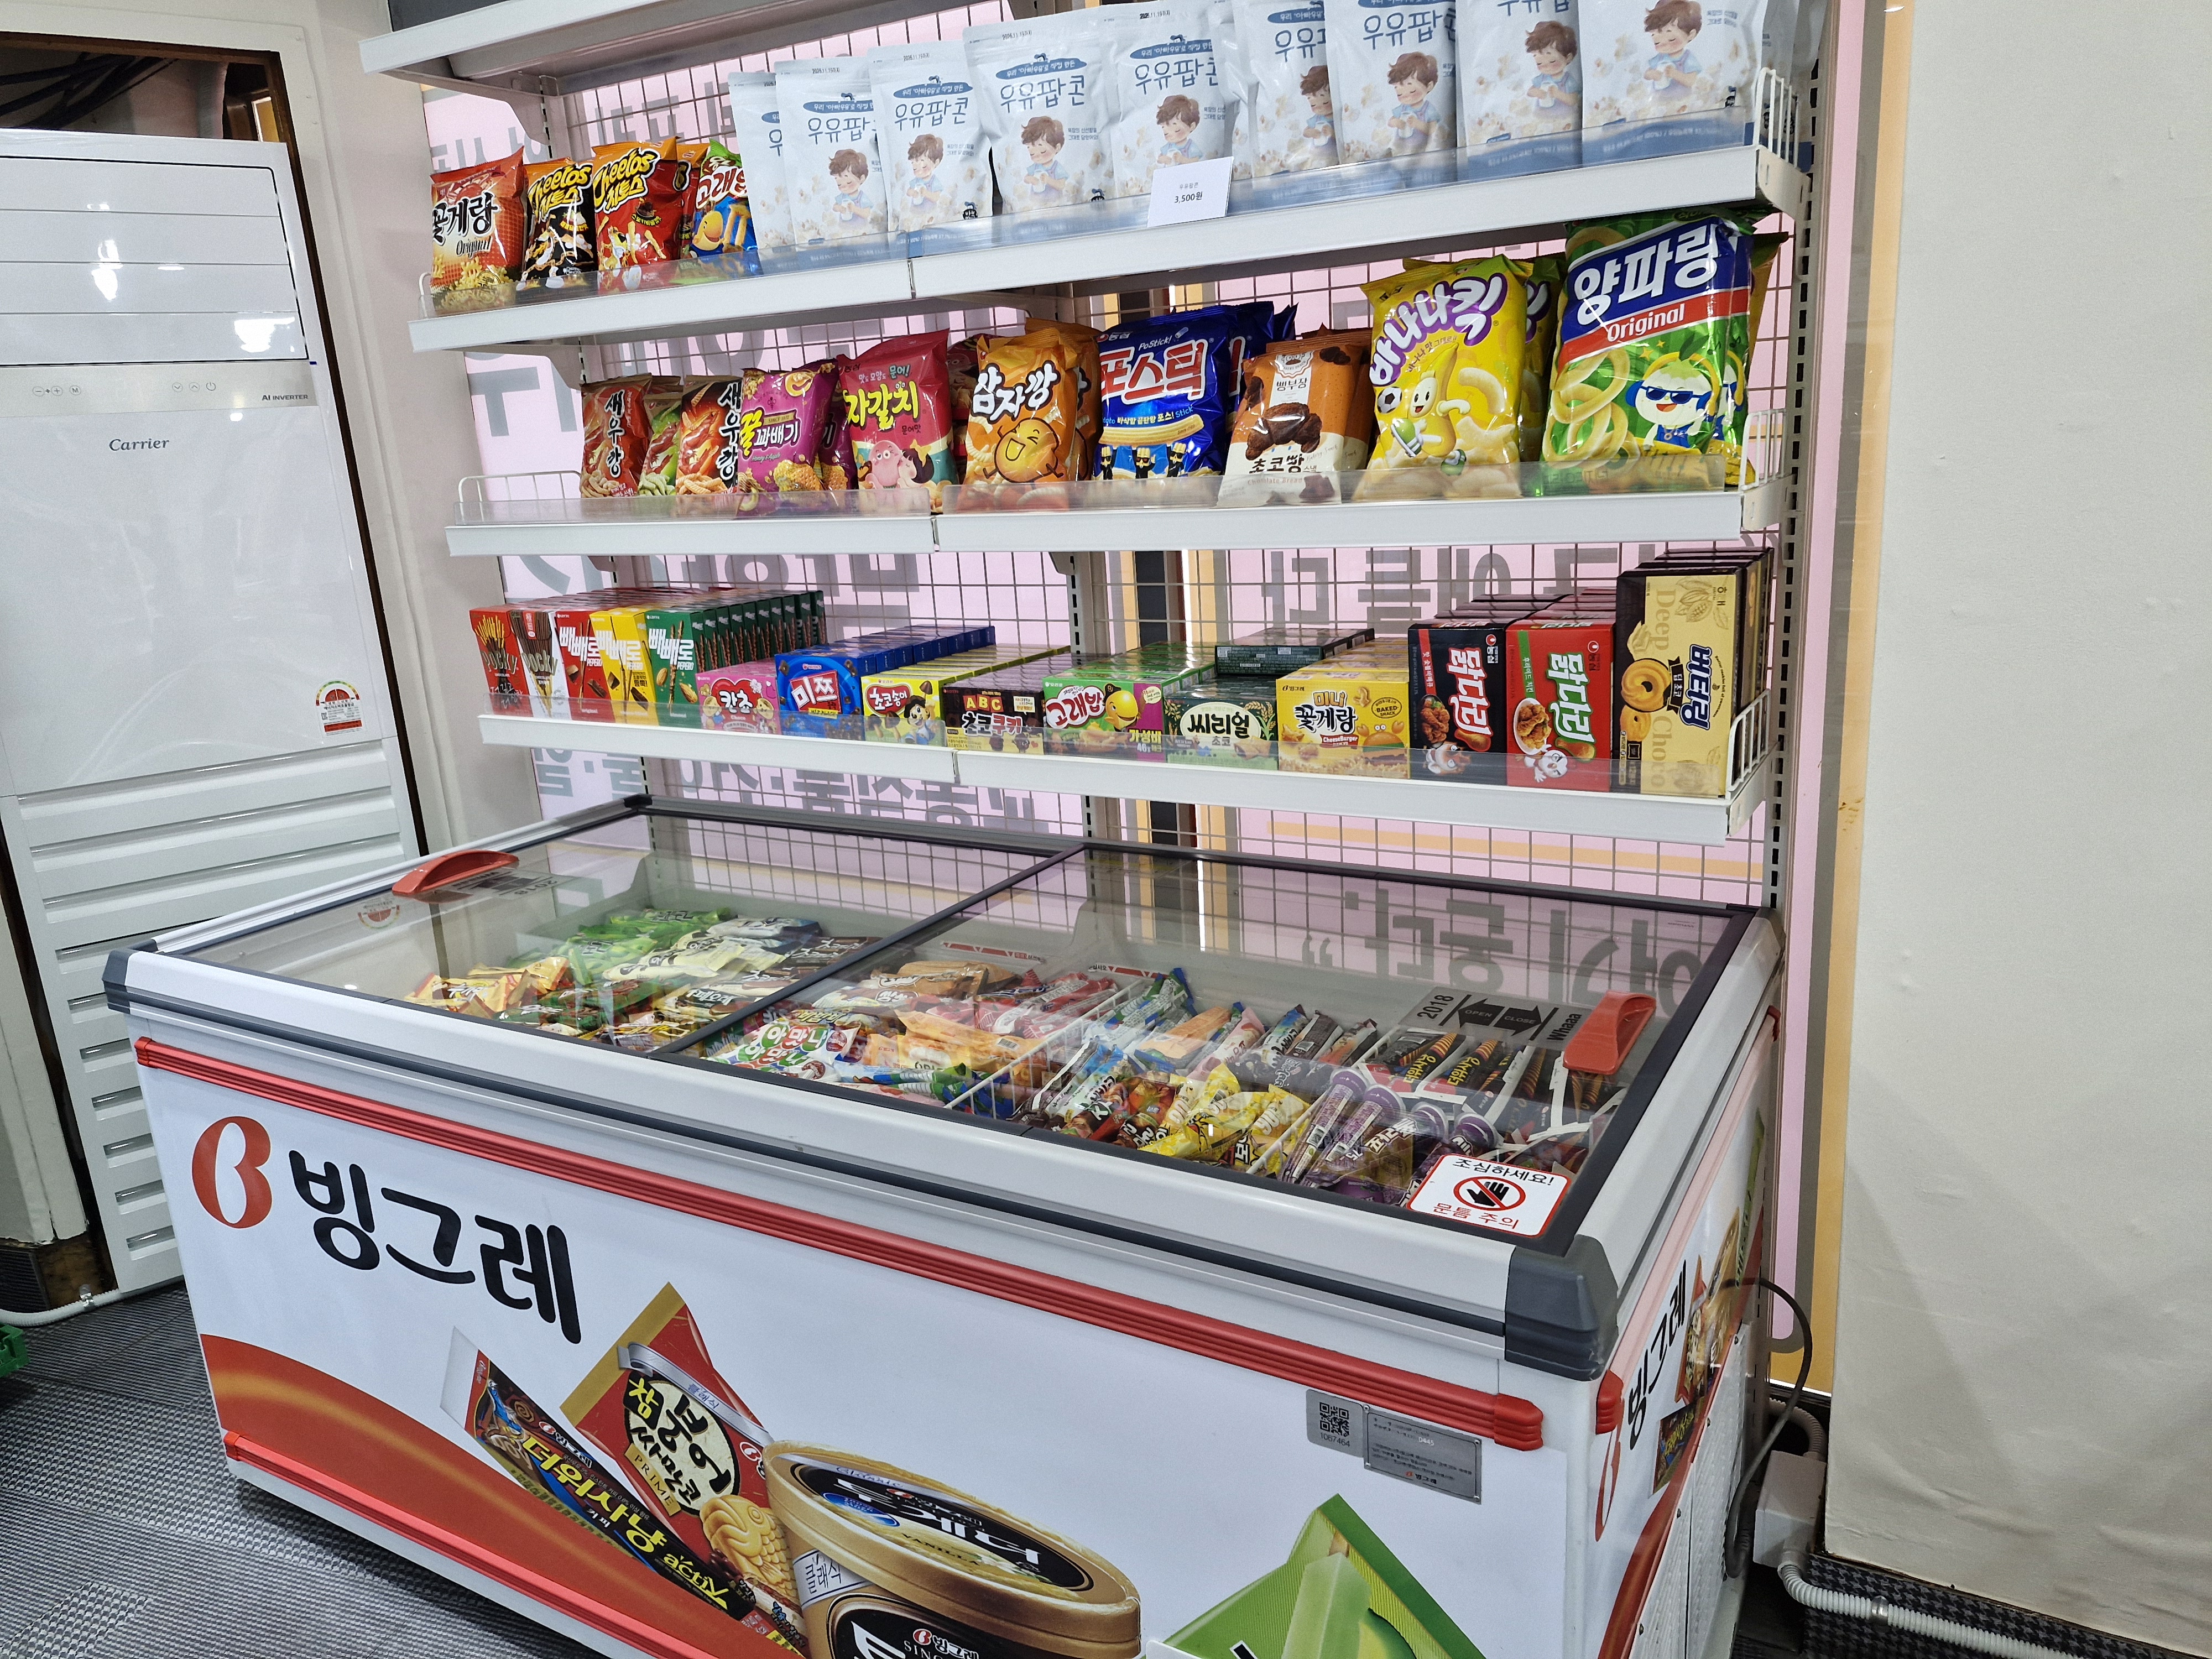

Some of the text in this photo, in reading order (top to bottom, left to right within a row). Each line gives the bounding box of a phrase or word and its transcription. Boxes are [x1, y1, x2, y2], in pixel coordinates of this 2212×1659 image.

[999, 75, 1086, 114] 우유팝콘
[894, 97, 969, 131] 우유팝콘
[807, 118, 877, 145] 우유팝
[606, 178, 645, 212] 치토스
[1173, 191, 1203, 204] 3,500원
[1180, 181, 1199, 191] 우유팝콘
[540, 187, 582, 216] 치토스
[456, 238, 492, 258] Original
[1574, 223, 1719, 326] 양파링
[1369, 275, 1505, 387] 바나나킥
[1607, 303, 1685, 342] Original
[1138, 336, 1172, 352] PoStick!
[1425, 341, 1434, 351] 맛
[858, 365, 911, 383] 맛도 모양도 문어!
[1099, 341, 1206, 403] 포스틱
[1276, 377, 1308, 392] 빵부장
[843, 381, 920, 431] 자갈치
[1157, 412, 1174, 422] 포스!
[1175, 406, 1193, 419] Stick
[605, 389, 625, 479] 새우깡
[718, 382, 743, 481] 새우깡
[740, 409, 799, 458] 꿀꽈배기
[901, 424, 922, 435] 문어맛
[108, 437, 170, 452] Carrier
[1249, 453, 1305, 474] 초코빵
[1304, 464, 1317, 473] 스낵
[1649, 588, 1677, 651] Deep
[559, 627, 599, 662] 빼빼로
[596, 630, 641, 666] 빼빼로
[649, 628, 694, 665] 빼빼로
[627, 661, 643, 670] PEPERO
[677, 661, 694, 670] PEPERO
[791, 676, 838, 707] 미쯔
[869, 687, 908, 710] 초코송이
[1313, 691, 1347, 708] 미니
[1448, 648, 1492, 736] 닭다리
[1548, 653, 1596, 743] 닭다리
[1673, 674, 1683, 698] 딥 초코
[1679, 645, 1712, 730] 버터링
[719, 691, 754, 712] 칸쵸
[966, 696, 1002, 712] ABC
[1045, 692, 1101, 726] 고래밥
[963, 713, 1022, 736] 초코쿠키
[1187, 711, 1250, 739] 씨리얼
[1295, 705, 1357, 733] 꽃게랑
[1129, 729, 1162, 744] 가성비
[1651, 716, 1673, 787] Choco
[1417, 995, 1454, 1019] 2018
[1464, 1009, 1493, 1018] OPEN
[1504, 1015, 1536, 1024] CLOSE
[766, 1026, 827, 1049] 아맛나
[1547, 1013, 1582, 1041] Whaaa
[748, 1046, 807, 1065] 아맛나
[1402, 1053, 1437, 1084] 더위사냥
[1447, 1055, 1481, 1086] 더위사냥
[1452, 1157, 1555, 1186] 조심하세요!
[1479, 1212, 1520, 1230] 주의
[288, 1150, 582, 1344] 빙그레
[1628, 1259, 1687, 1451] 빙그레
[627, 1376, 661, 1421] 참
[554, 1431, 594, 1469] 빙그레
[1319, 1431, 1351, 1448] 1067464
[630, 1426, 701, 1506] 싸만코
[523, 1436, 667, 1554] 더위사냥
[633, 1454, 676, 1509] PRIME
[586, 1508, 611, 1528] 커피
[901, 1532, 981, 1567] VANILLA
[805, 1561, 842, 1595] 클래식
[932, 1636, 979, 1659] 빙그레
